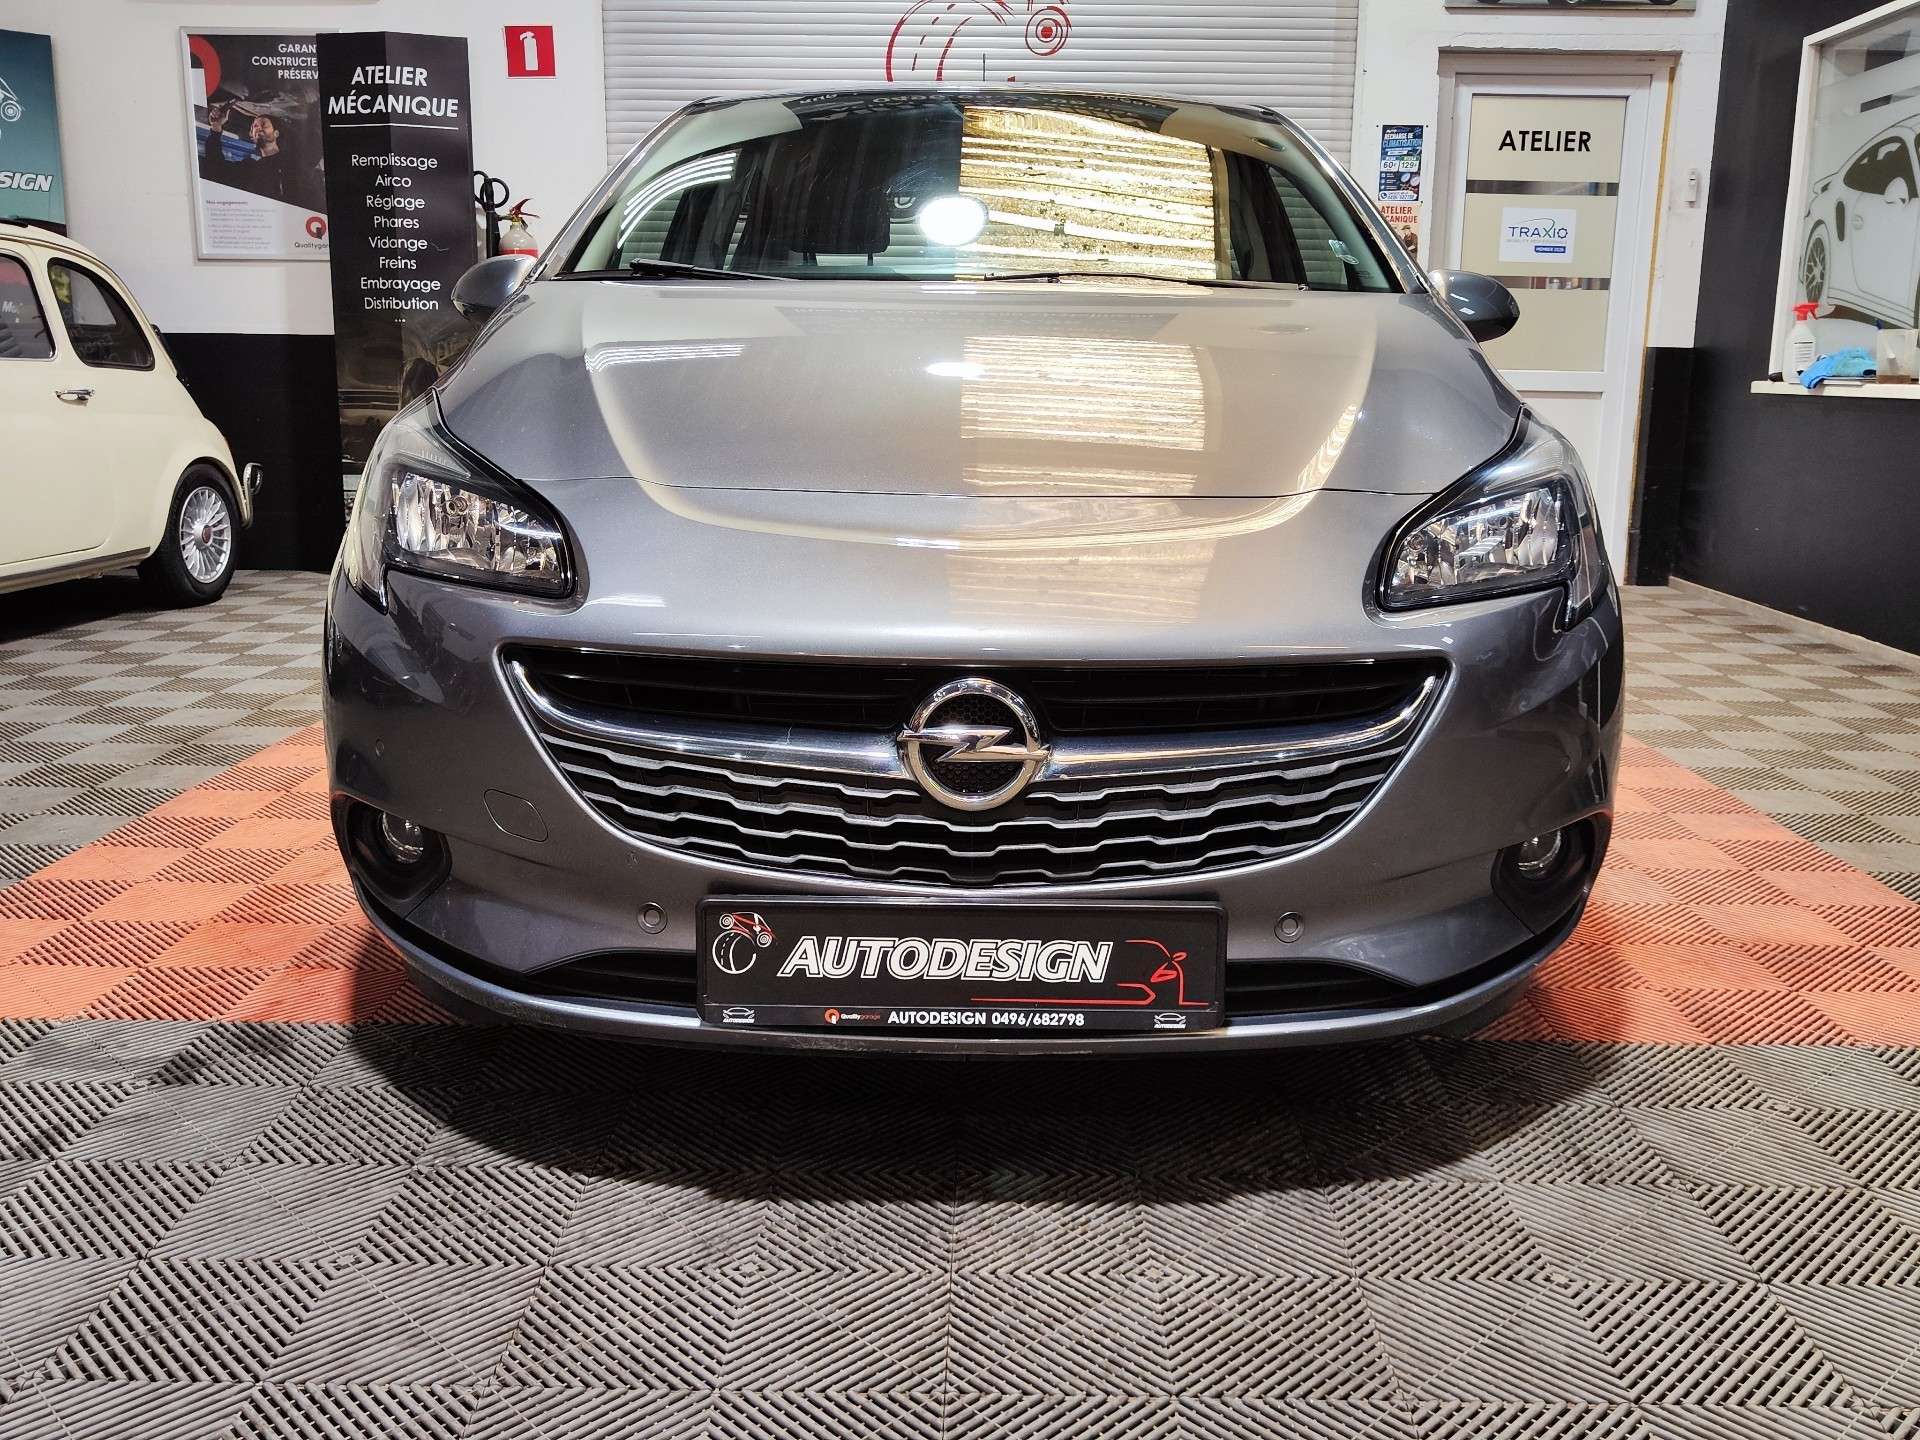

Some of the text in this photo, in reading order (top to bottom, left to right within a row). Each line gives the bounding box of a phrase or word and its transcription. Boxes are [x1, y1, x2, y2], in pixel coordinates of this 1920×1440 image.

[251, 56, 318, 66] CONSTRUCTE
[351, 65, 428, 87] ATELIER
[327, 90, 459, 117] MÉCANIQUE
[1498, 130, 1592, 152] ATELIER
[351, 153, 438, 170] Remplissage
[375, 174, 412, 187] Airco
[366, 194, 425, 211] Réglage
[1380, 206, 1413, 214] ATELIER
[373, 215, 420, 229] Phares
[1507, 223, 1568, 239] TRAXIO
[368, 236, 428, 251] Vidange
[379, 255, 417, 269] Freins
[360, 277, 441, 292] Embrayage
[364, 297, 439, 310] Distribution
[777, 935, 1113, 983] AUTODESIGN
[887, 1011, 1085, 1027] AUTODESIGN 0496/682798
